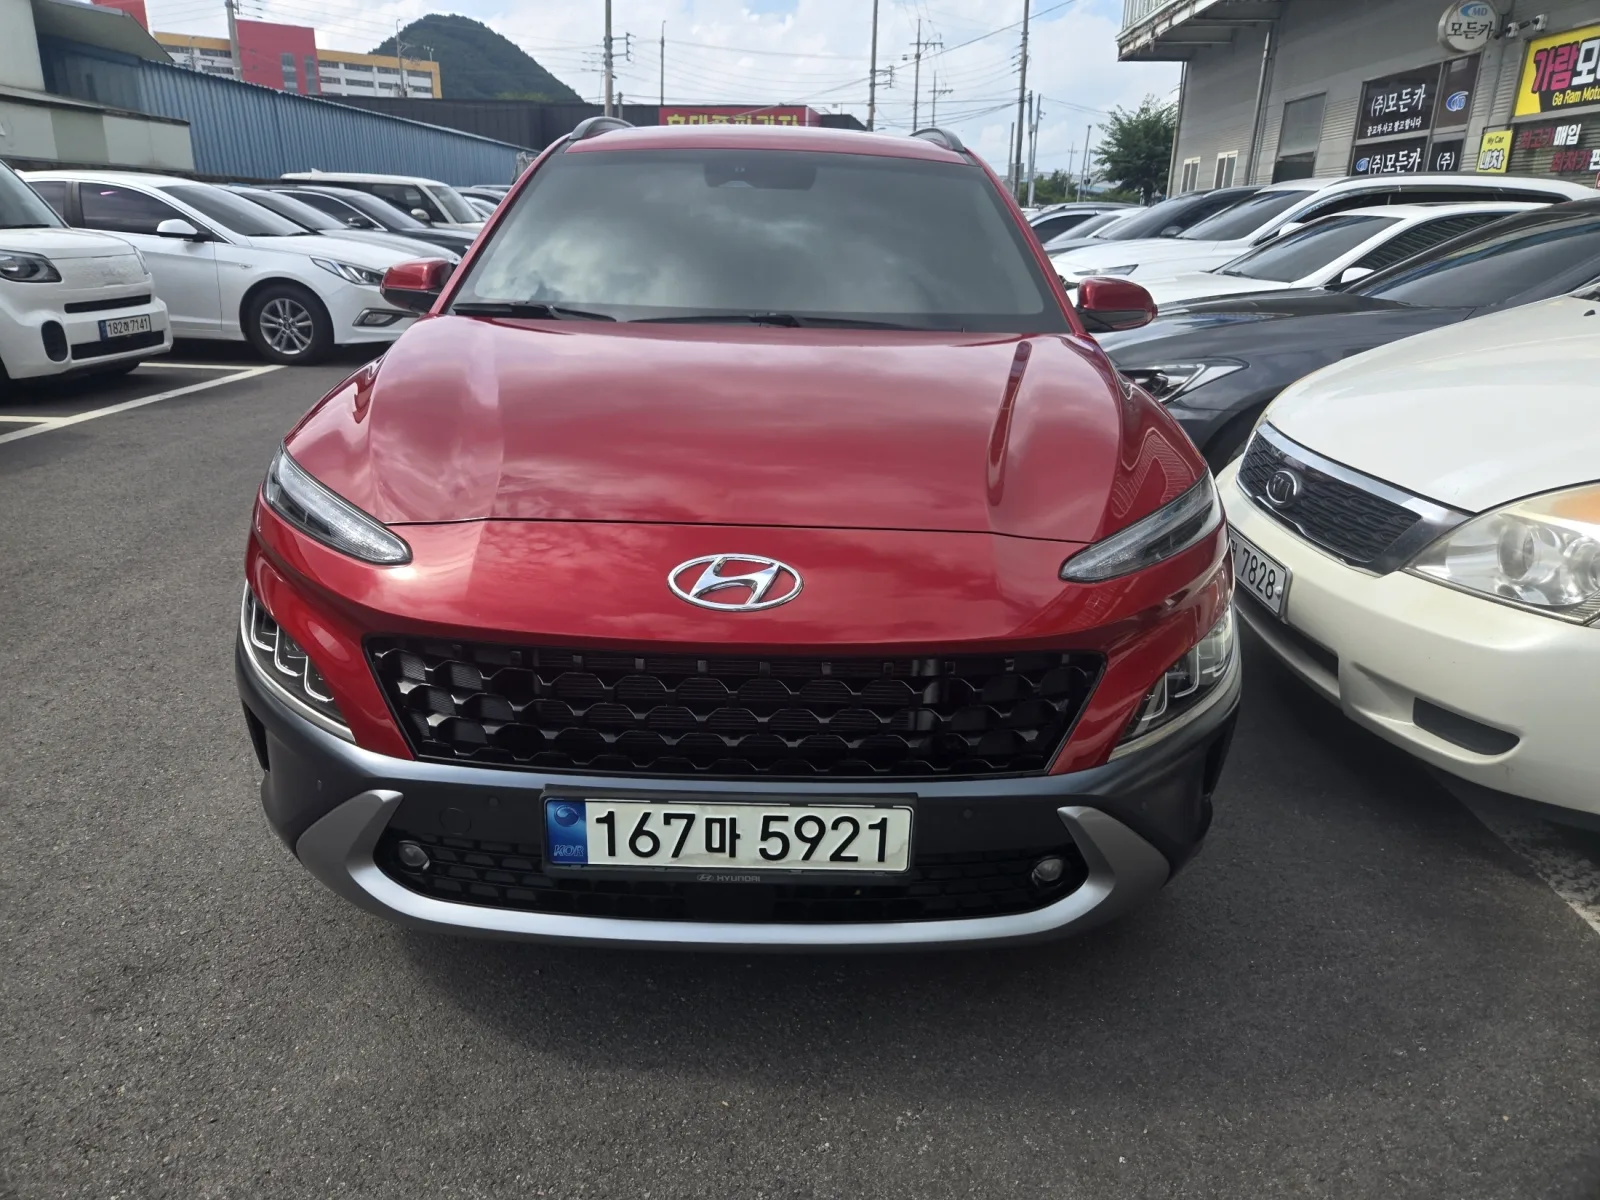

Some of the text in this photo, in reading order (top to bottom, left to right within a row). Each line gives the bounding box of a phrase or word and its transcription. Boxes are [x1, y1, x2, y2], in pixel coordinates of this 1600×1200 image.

[1447, 21, 1493, 40] 모든카
[1532, 38, 1600, 92] 가람모
[1371, 84, 1426, 117] (주)모든카
[1552, 92, 1564, 106] Ga
[1564, 90, 1581, 104] Ram
[1495, 135, 1504, 143] Car
[1553, 124, 1581, 146] 매입
[1369, 148, 1421, 174] (주)모든카
[1437, 151, 1455, 171] (주)
[1480, 149, 1504, 169] 내차
[130, 318, 148, 331] 7141
[1241, 547, 1276, 600] 7828
[595, 810, 888, 863] 167마 5921
[554, 844, 584, 857] KOR
[717, 875, 761, 883] HYUNDAI
